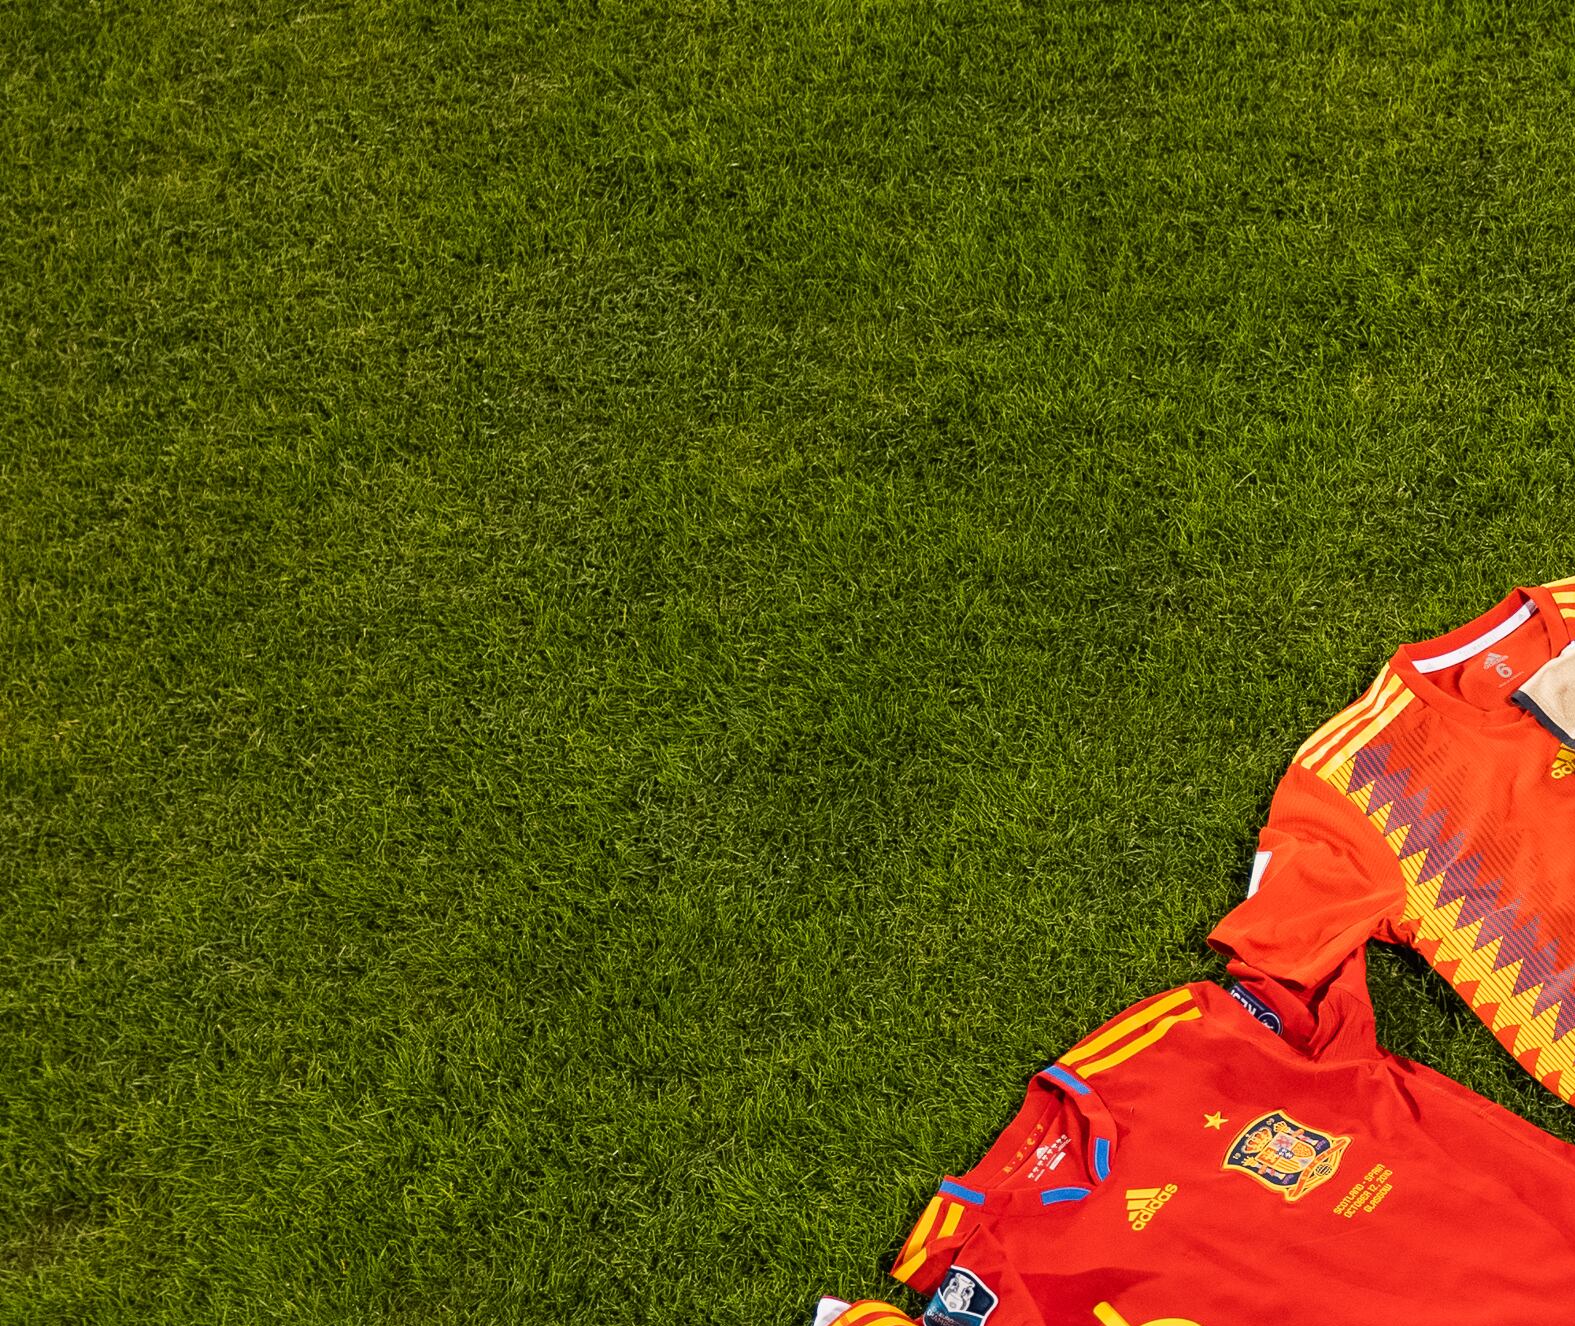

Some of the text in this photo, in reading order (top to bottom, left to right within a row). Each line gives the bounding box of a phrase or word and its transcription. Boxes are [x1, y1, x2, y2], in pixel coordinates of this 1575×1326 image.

[1130, 1182, 1179, 1231] adidas
[1333, 1183, 1365, 1215] SCOTLAND
[1364, 1163, 1386, 1182] SPAIN
[1344, 1190, 1373, 1218] OCTOBER
[1376, 1169, 1393, 1184] 2010
[1363, 1183, 1393, 1213] GLASGOW
